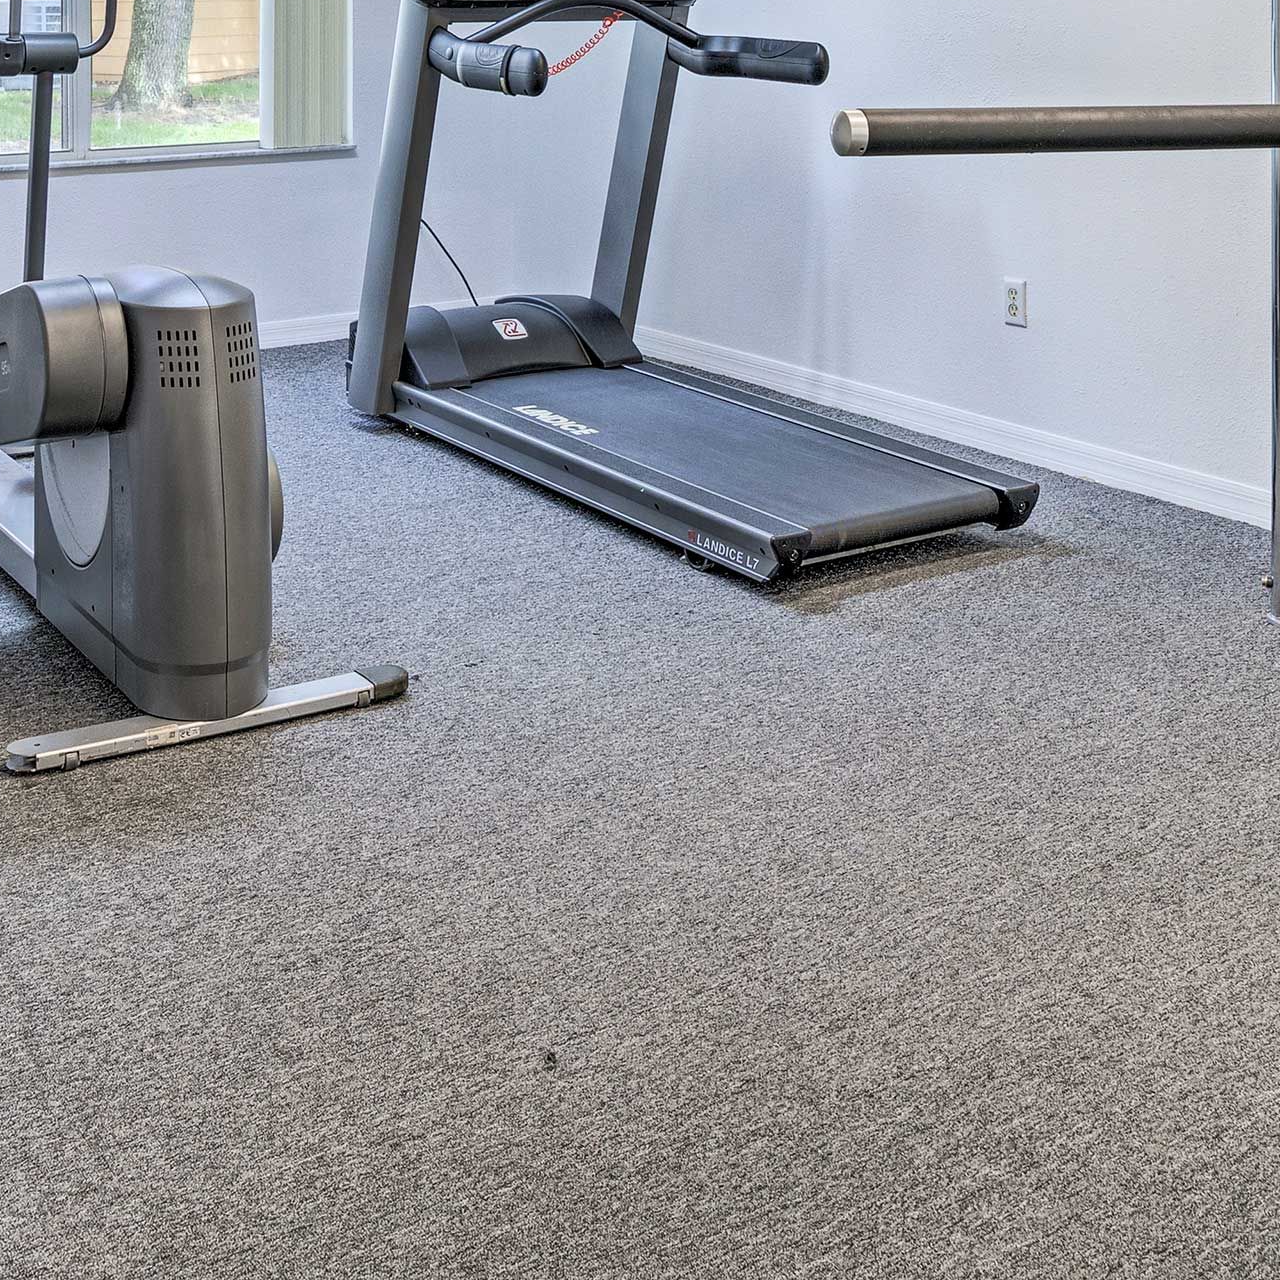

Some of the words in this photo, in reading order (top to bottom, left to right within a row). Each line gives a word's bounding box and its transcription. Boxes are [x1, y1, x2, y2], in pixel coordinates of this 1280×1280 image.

[512, 405, 599, 436] LANDICE
[697, 534, 743, 564] LANDICE
[746, 556, 759, 570] L7
